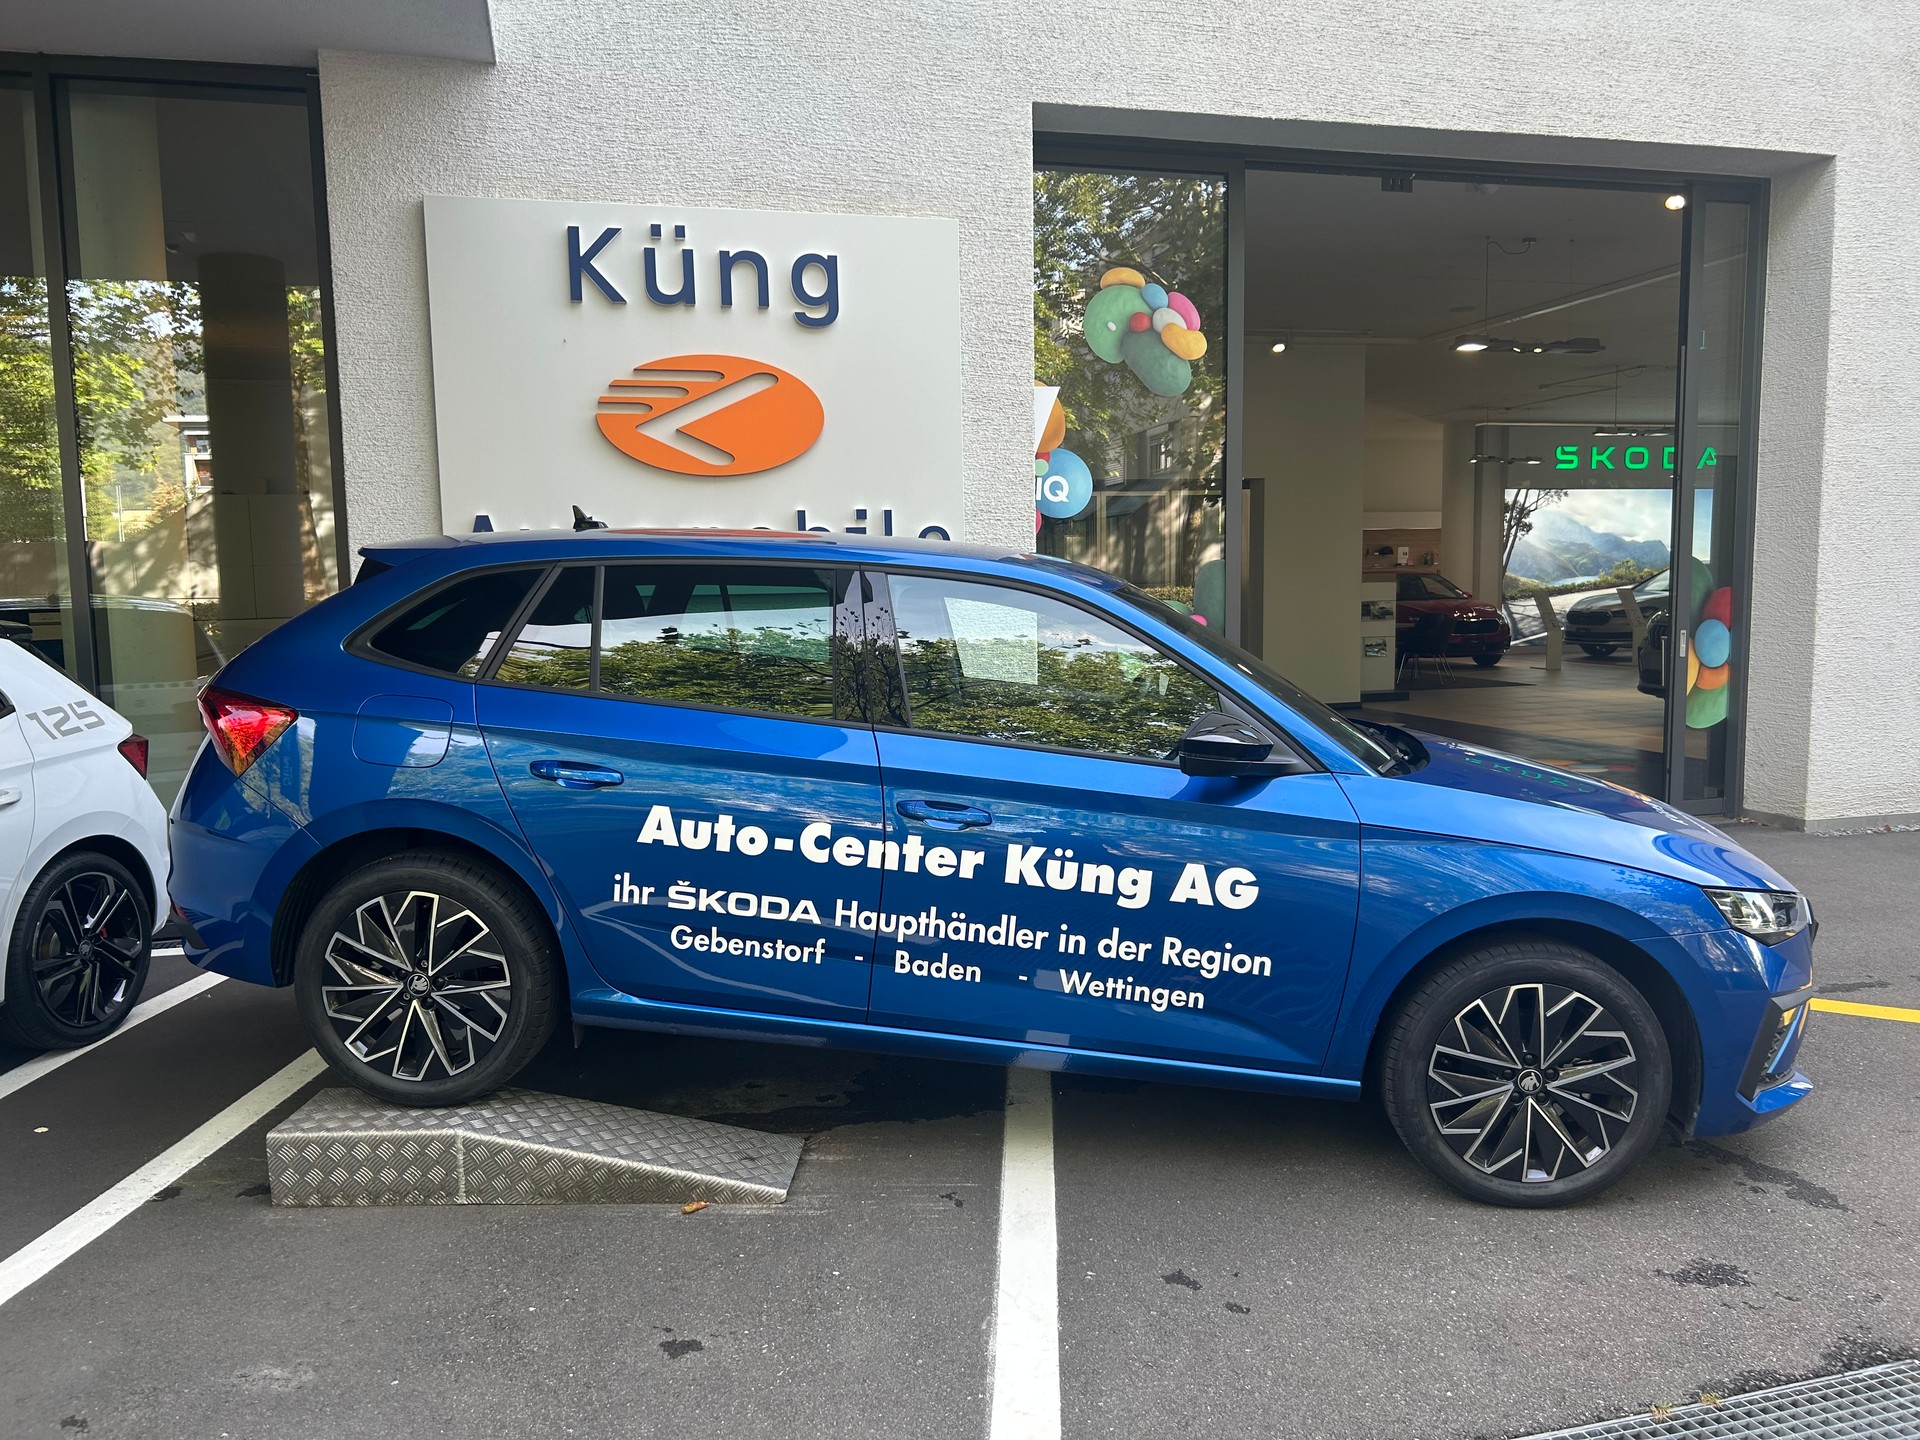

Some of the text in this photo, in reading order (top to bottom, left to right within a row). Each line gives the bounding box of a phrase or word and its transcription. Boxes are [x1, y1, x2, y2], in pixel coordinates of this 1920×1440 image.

[567, 224, 840, 328] Küng
[25, 700, 106, 740] 125
[636, 804, 1260, 910] Auto-Center Küng AG
[613, 872, 1272, 979] ihr ŠKODA Haupthändler in der Region
[670, 925, 826, 964] Gebenstorf
[894, 949, 982, 983] Baden
[1059, 968, 1205, 1012] Wettingen
